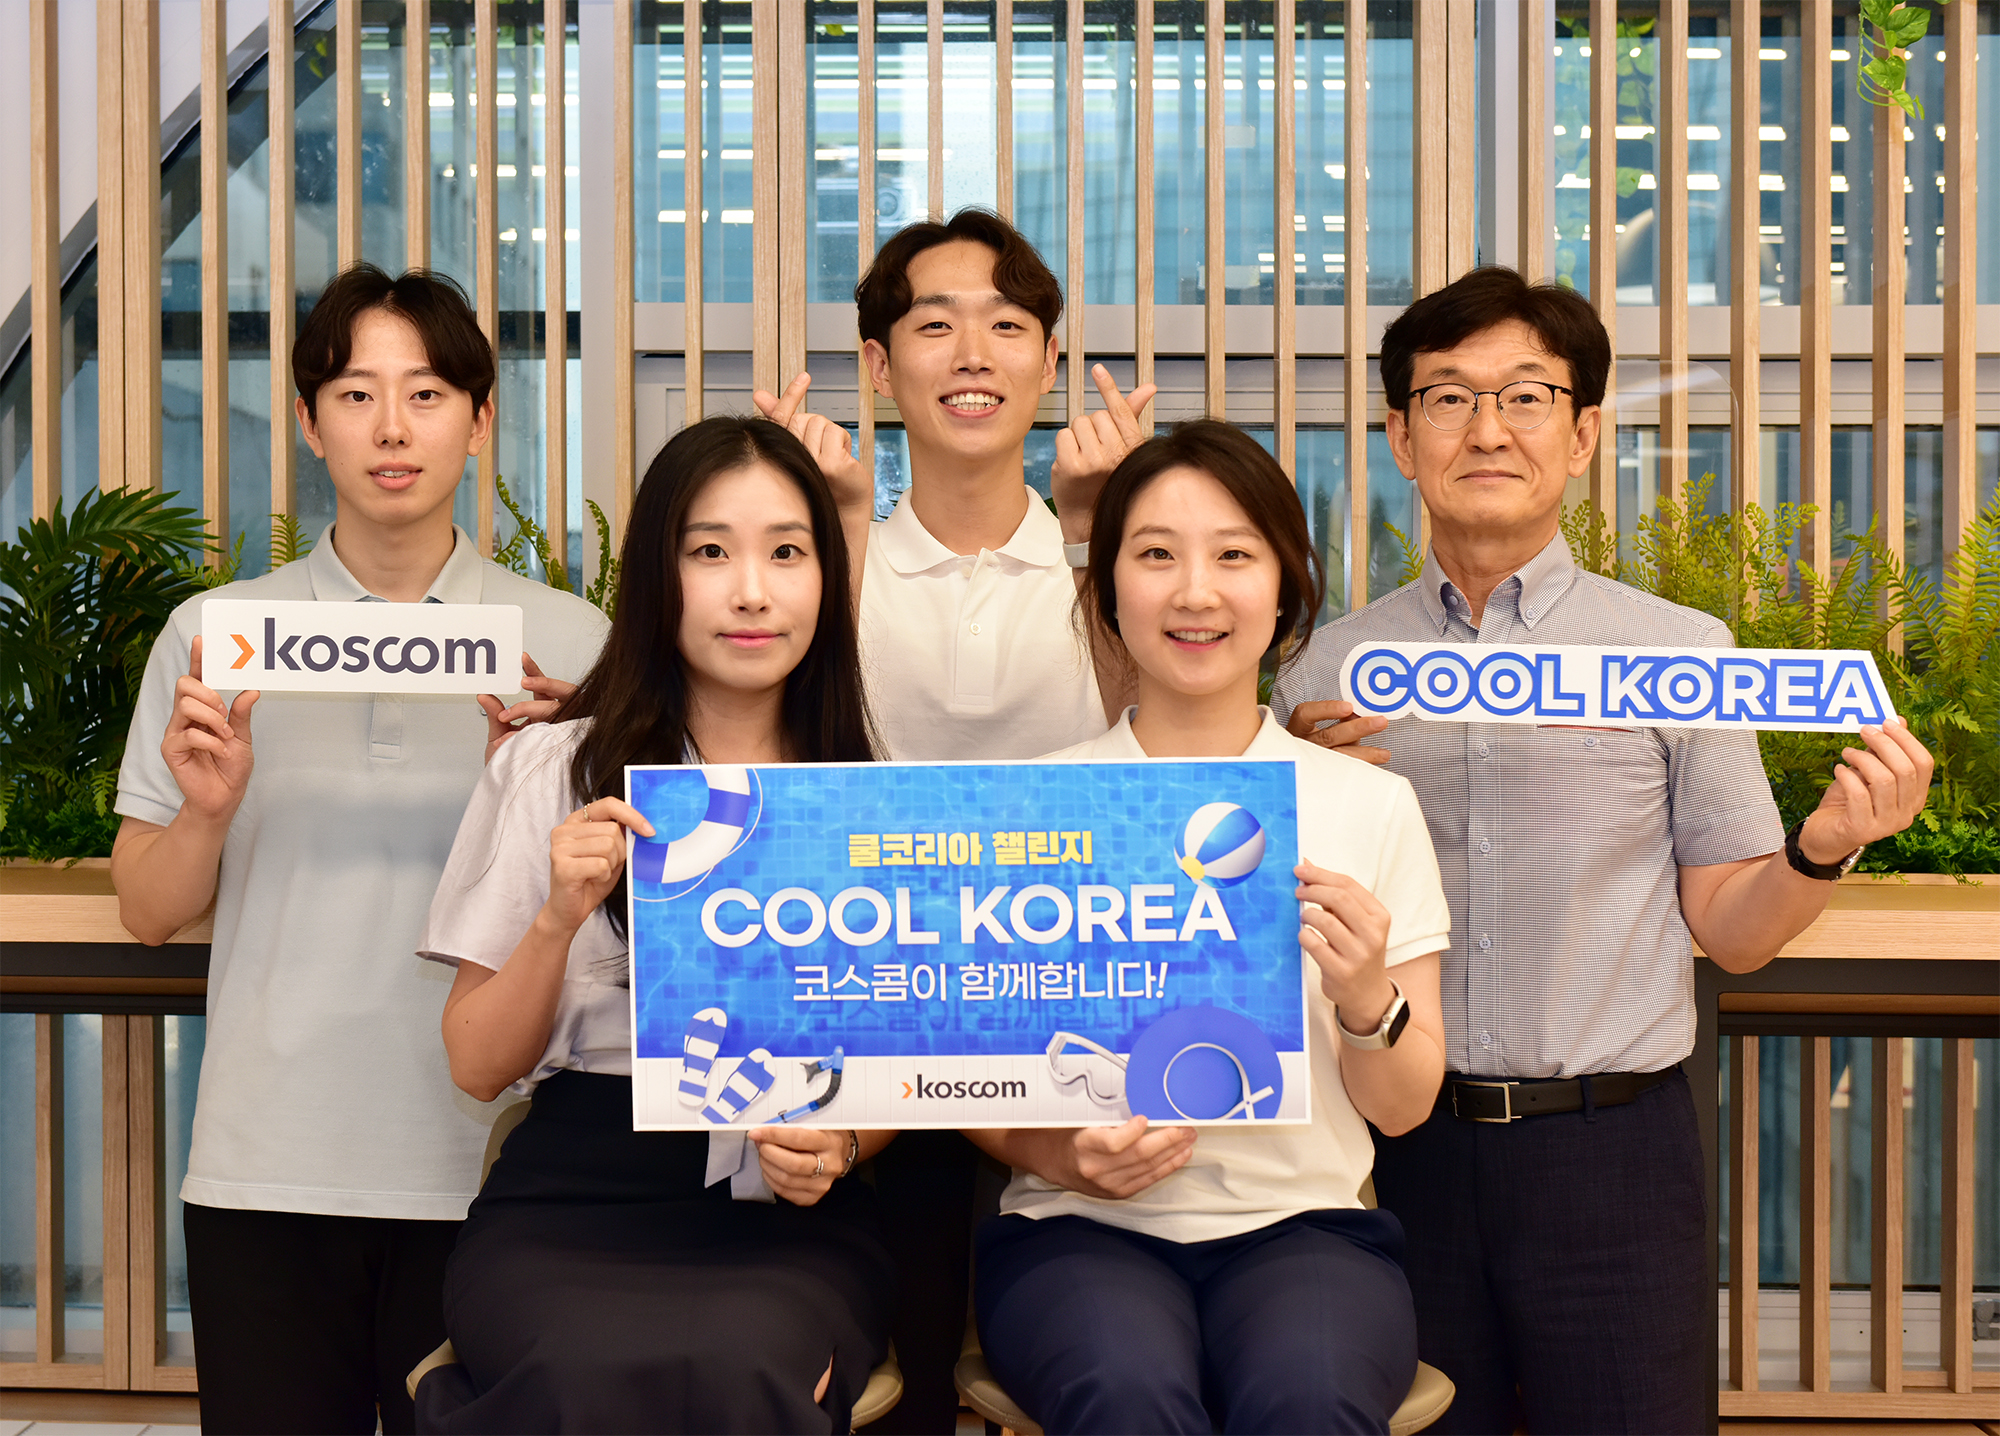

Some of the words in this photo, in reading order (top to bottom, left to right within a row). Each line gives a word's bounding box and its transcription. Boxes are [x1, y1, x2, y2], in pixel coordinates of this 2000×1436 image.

[264, 617, 497, 675] koscom
[1350, 648, 1586, 718] COOL
[1601, 654, 1886, 725] KOREA
[847, 830, 983, 867] 쿨코리아
[992, 829, 1093, 866] 챌린지
[700, 886, 941, 948] COOL
[960, 883, 1237, 944] KOREA
[792, 963, 948, 1003] 코스콤이
[958, 961, 1168, 1001] 함께합니다!
[915, 1073, 1027, 1100] koscom
